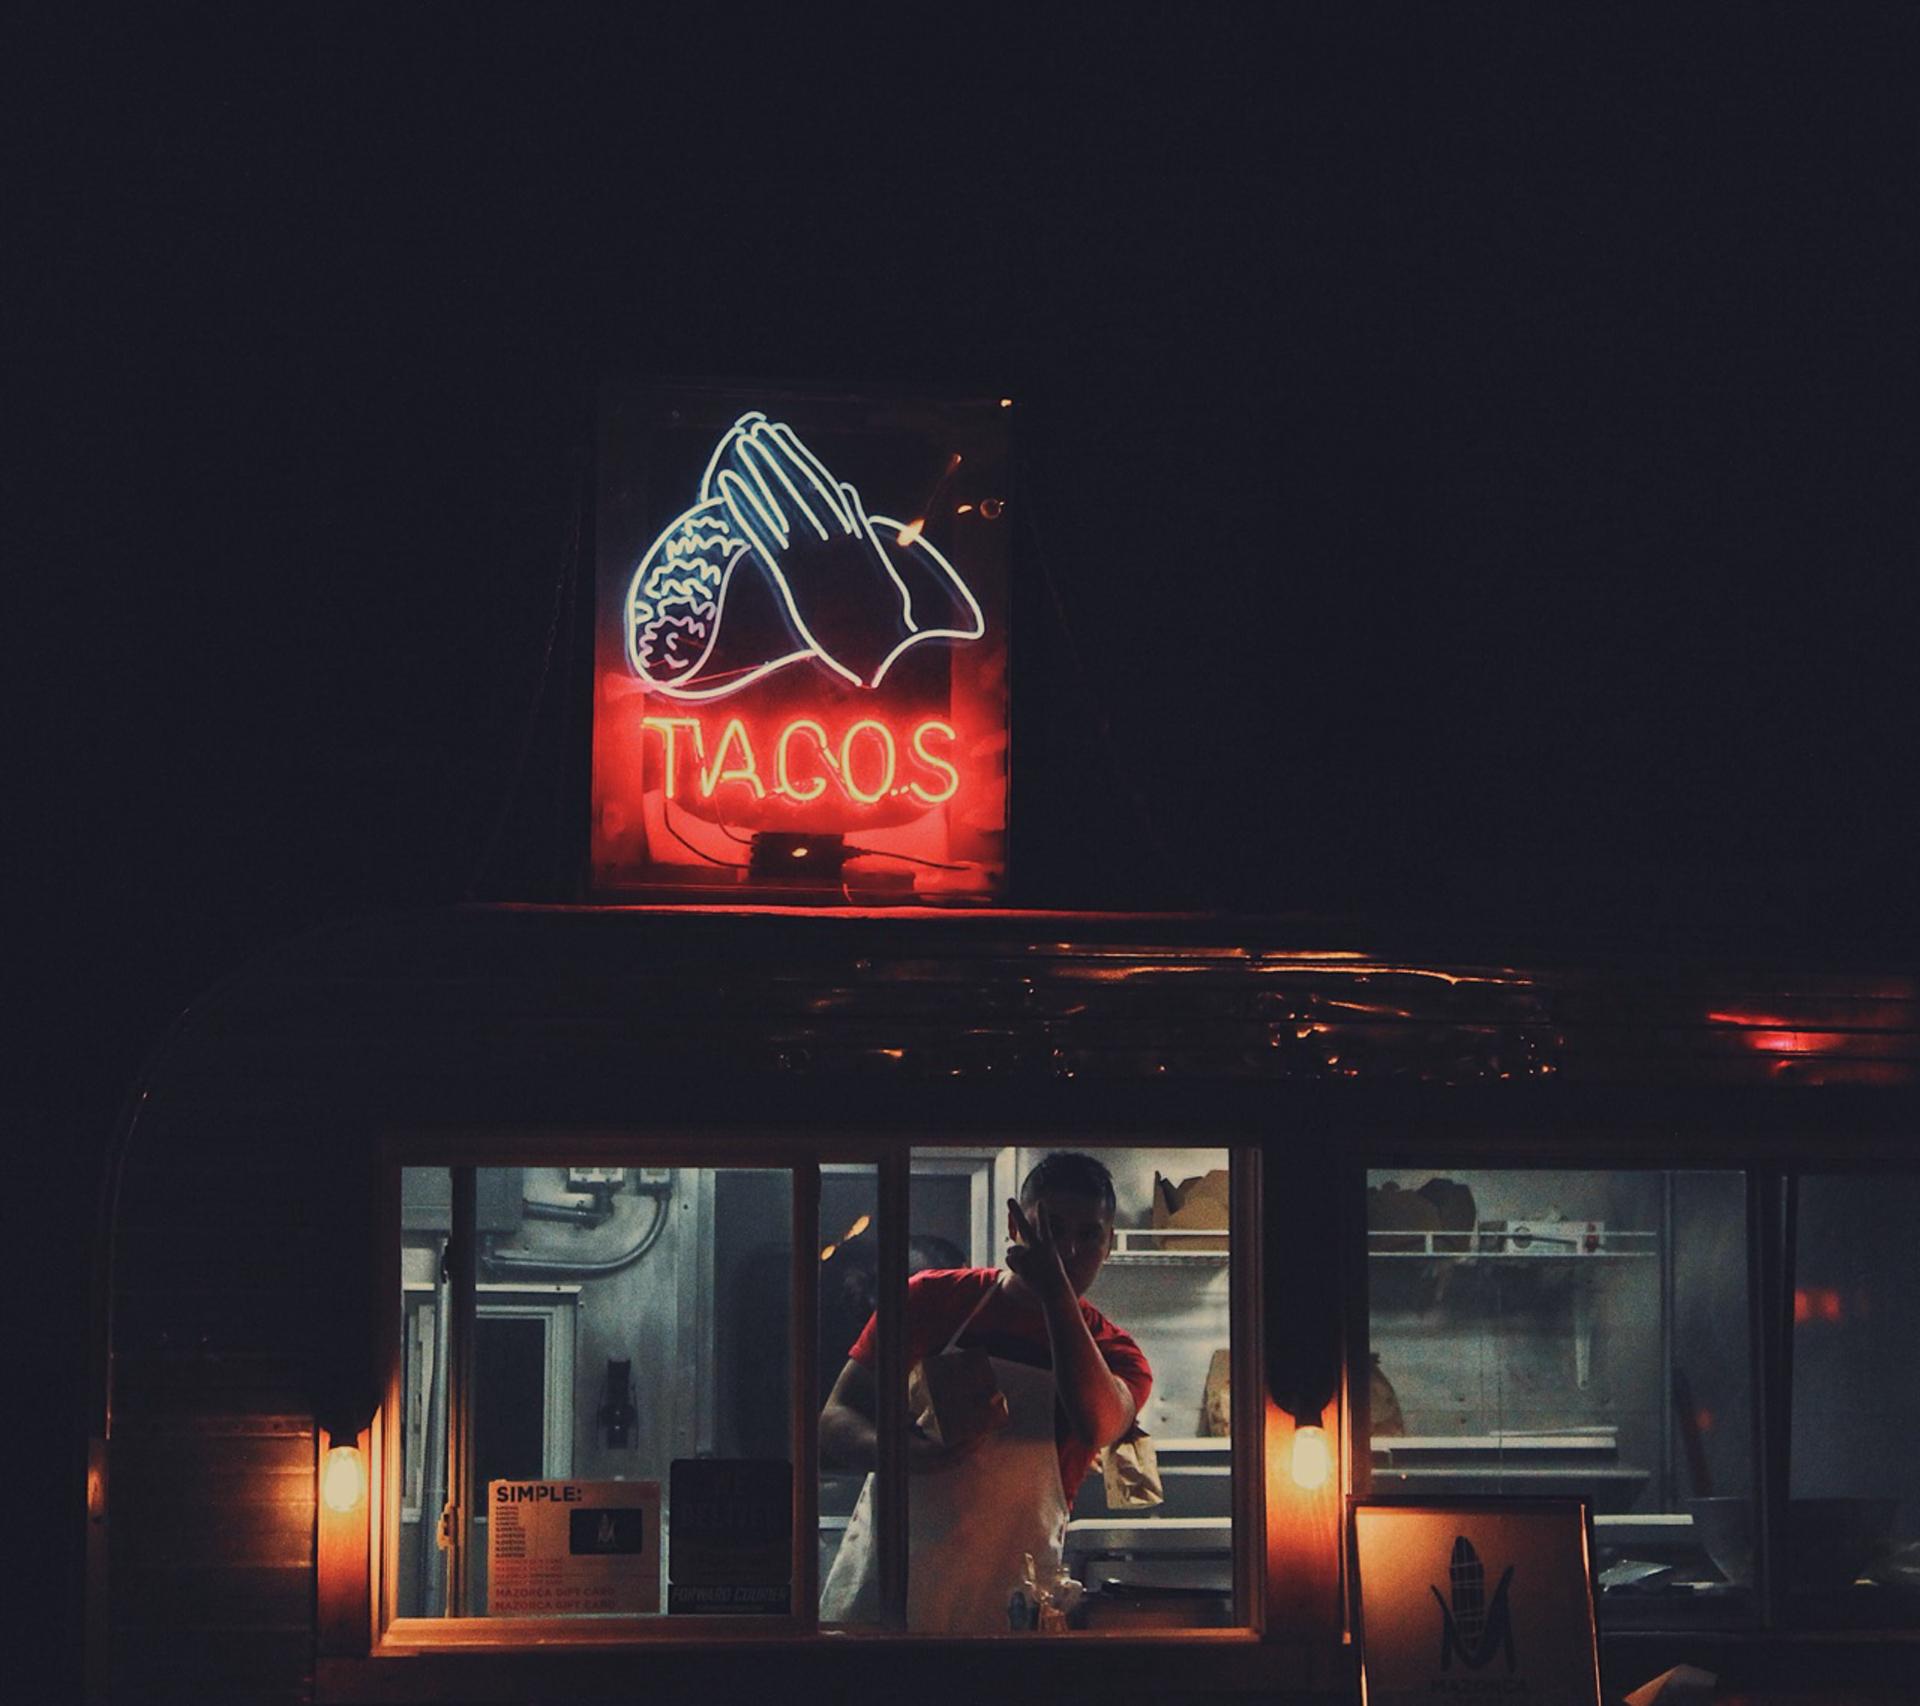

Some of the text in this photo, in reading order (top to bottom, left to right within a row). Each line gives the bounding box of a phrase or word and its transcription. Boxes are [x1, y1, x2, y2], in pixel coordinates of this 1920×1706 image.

[641, 716, 960, 804] TACOS
[496, 1485, 582, 1503] SIMPLE:
[495, 1588, 552, 1598] MAZORCA
[555, 1588, 581, 1598] GIFT
[495, 1601, 552, 1610] MAZORCA
[555, 1601, 581, 1610] GIFT
